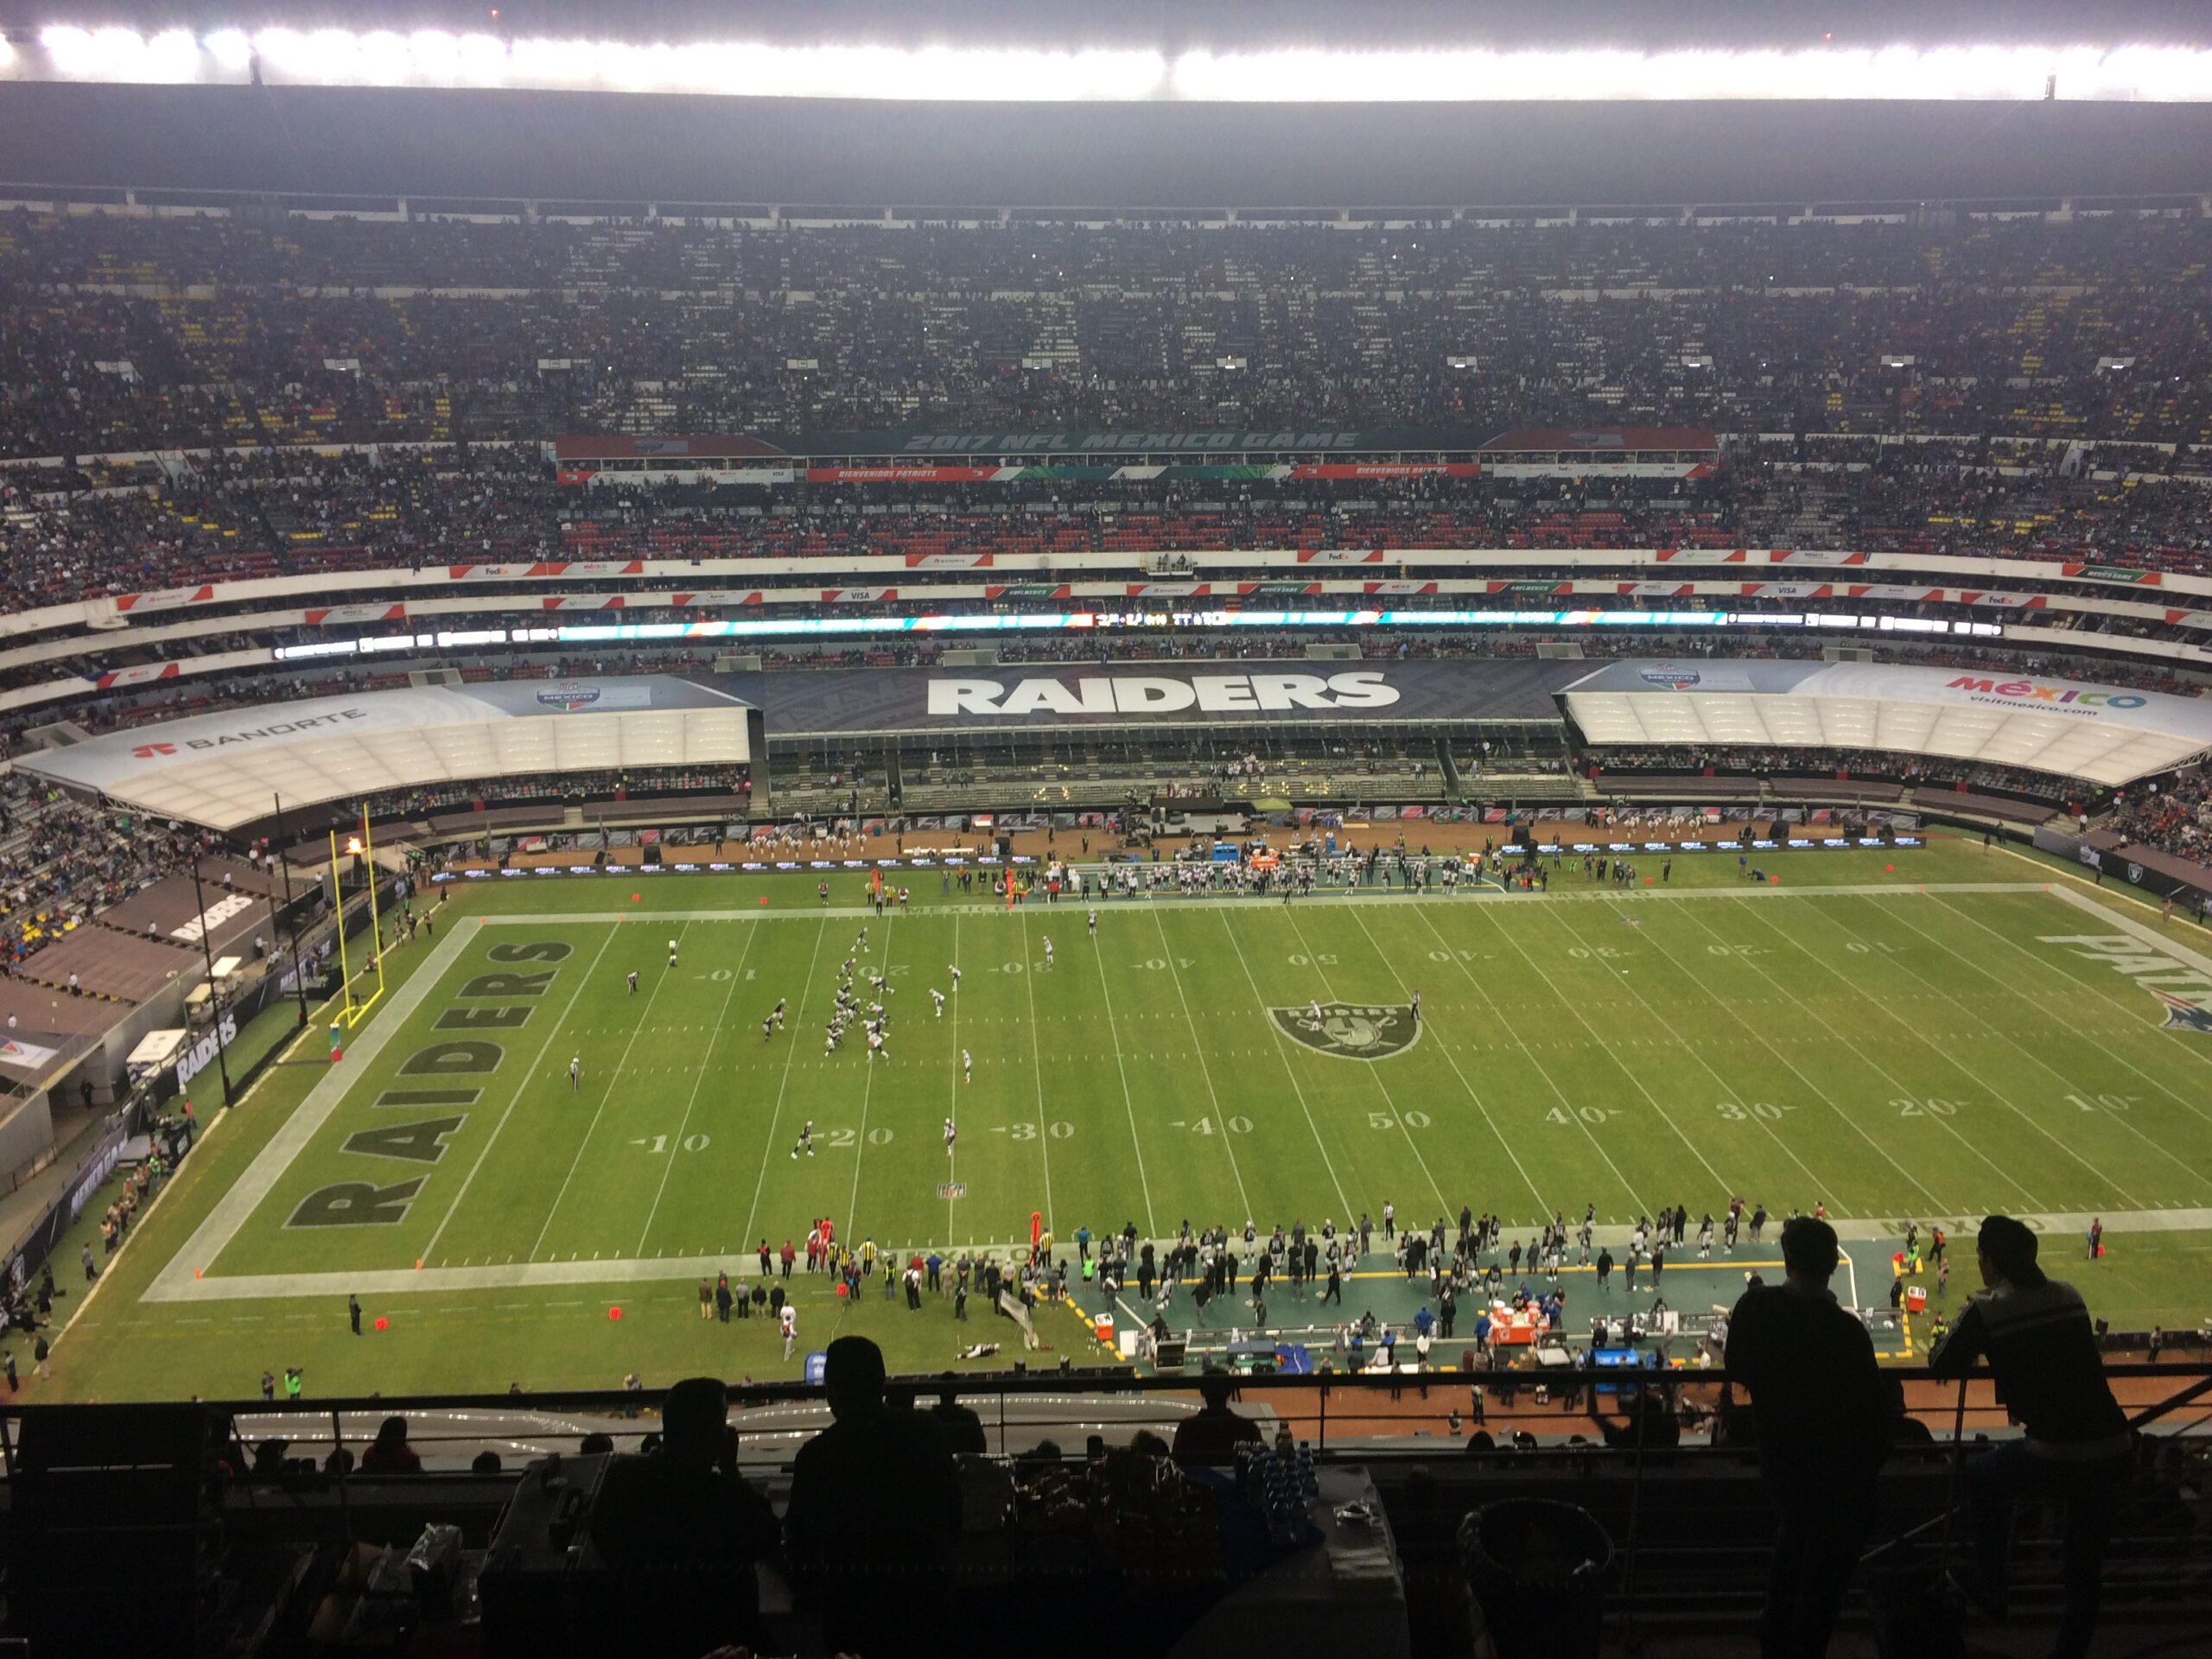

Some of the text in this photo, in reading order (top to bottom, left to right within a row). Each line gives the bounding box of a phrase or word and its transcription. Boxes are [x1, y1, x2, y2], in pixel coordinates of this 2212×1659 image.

[905, 432, 1361, 450] 2017 NFL MEXICO GAME
[485, 567, 510, 576] FedEx
[1989, 595, 2013, 604] FedEx
[926, 670, 1402, 716] RAIDERS
[1970, 695, 2098, 716] visitmexico.com
[185, 708, 367, 749] BANORTE
[170, 894, 253, 941] RAIDERS
[1287, 1007, 1398, 1018] RAIDERS
[176, 1013, 237, 1085] RAIDERS
[281, 941, 575, 1230] RAIDERS
[1716, 1102, 1783, 1121] 30
[1888, 1098, 1958, 1117] 20
[2063, 1093, 2130, 1112] 10
[1367, 1110, 1433, 1130] 50
[1545, 1105, 1607, 1124] 40
[1011, 1121, 1076, 1141] 30
[1192, 1116, 1255, 1135] 40
[647, 1134, 711, 1154] 10
[828, 1128, 893, 1148] 20
[1880, 1217, 2045, 1236] MEXO
